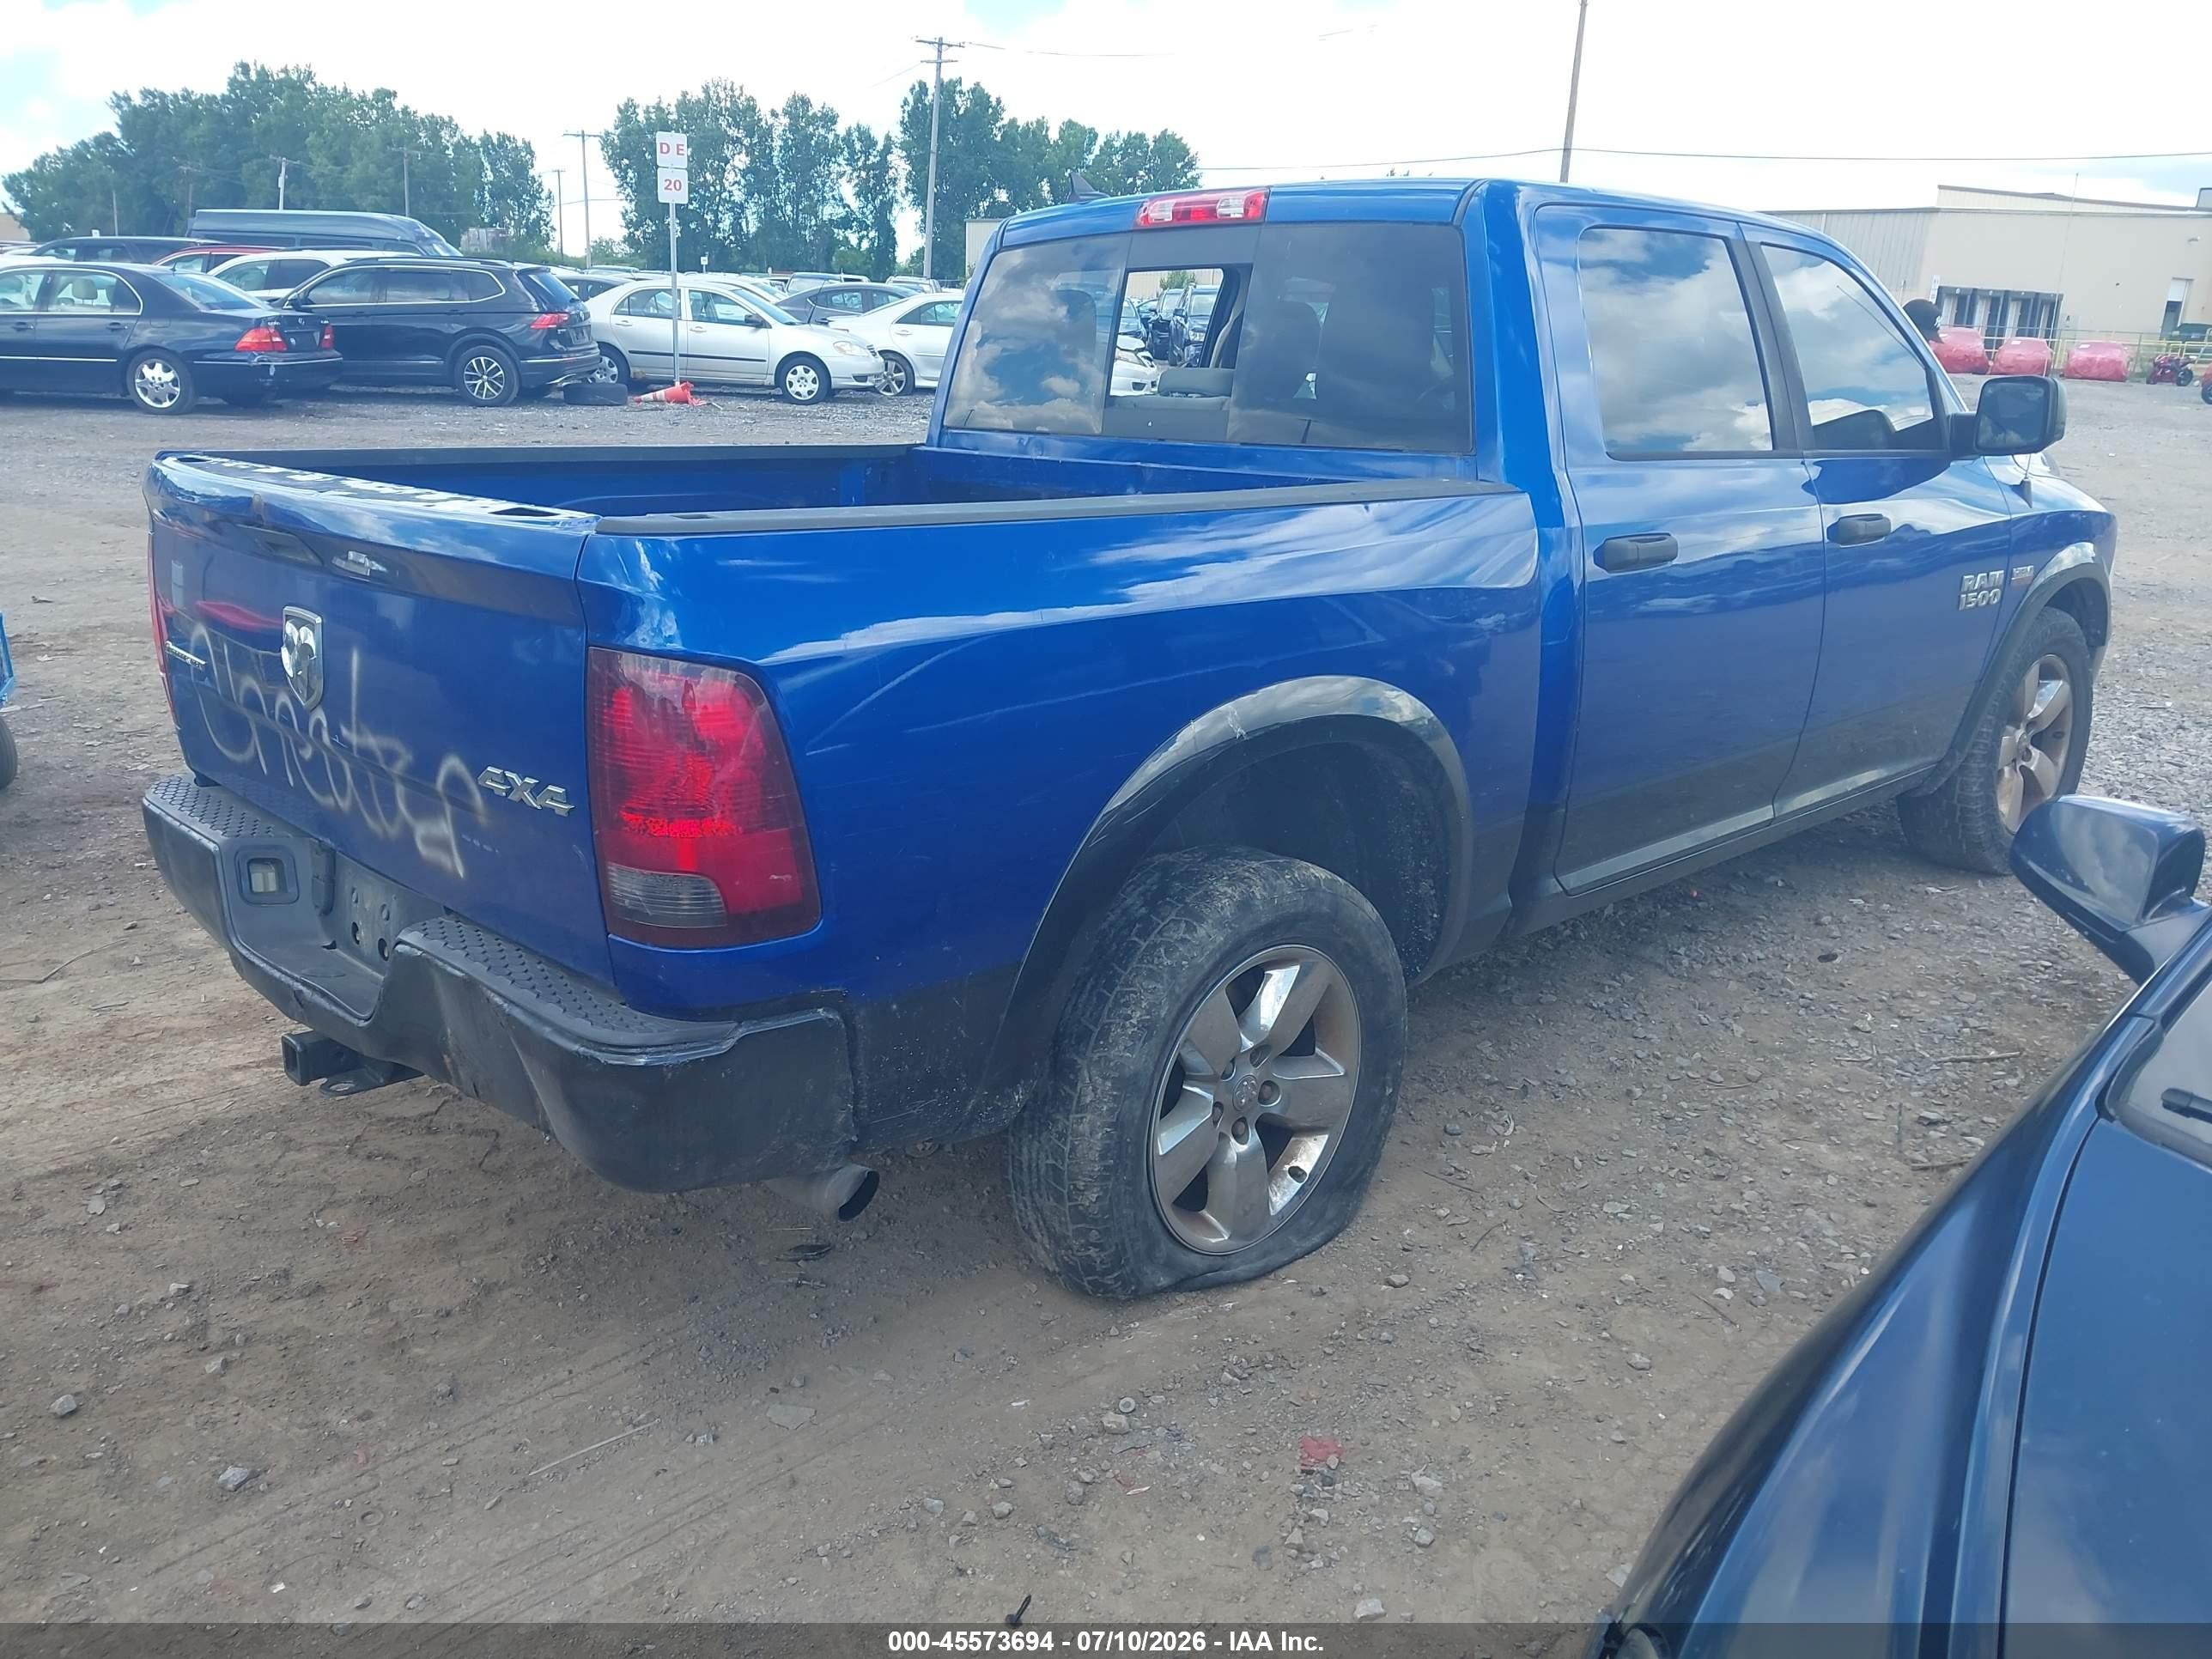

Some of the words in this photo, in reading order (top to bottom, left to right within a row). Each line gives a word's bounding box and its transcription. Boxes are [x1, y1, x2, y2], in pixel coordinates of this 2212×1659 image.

[659, 142, 671, 155] D
[676, 143, 685, 155] E
[664, 179, 682, 191] 20
[1961, 570, 2004, 592] RAM
[1959, 588, 2001, 611] 1500
